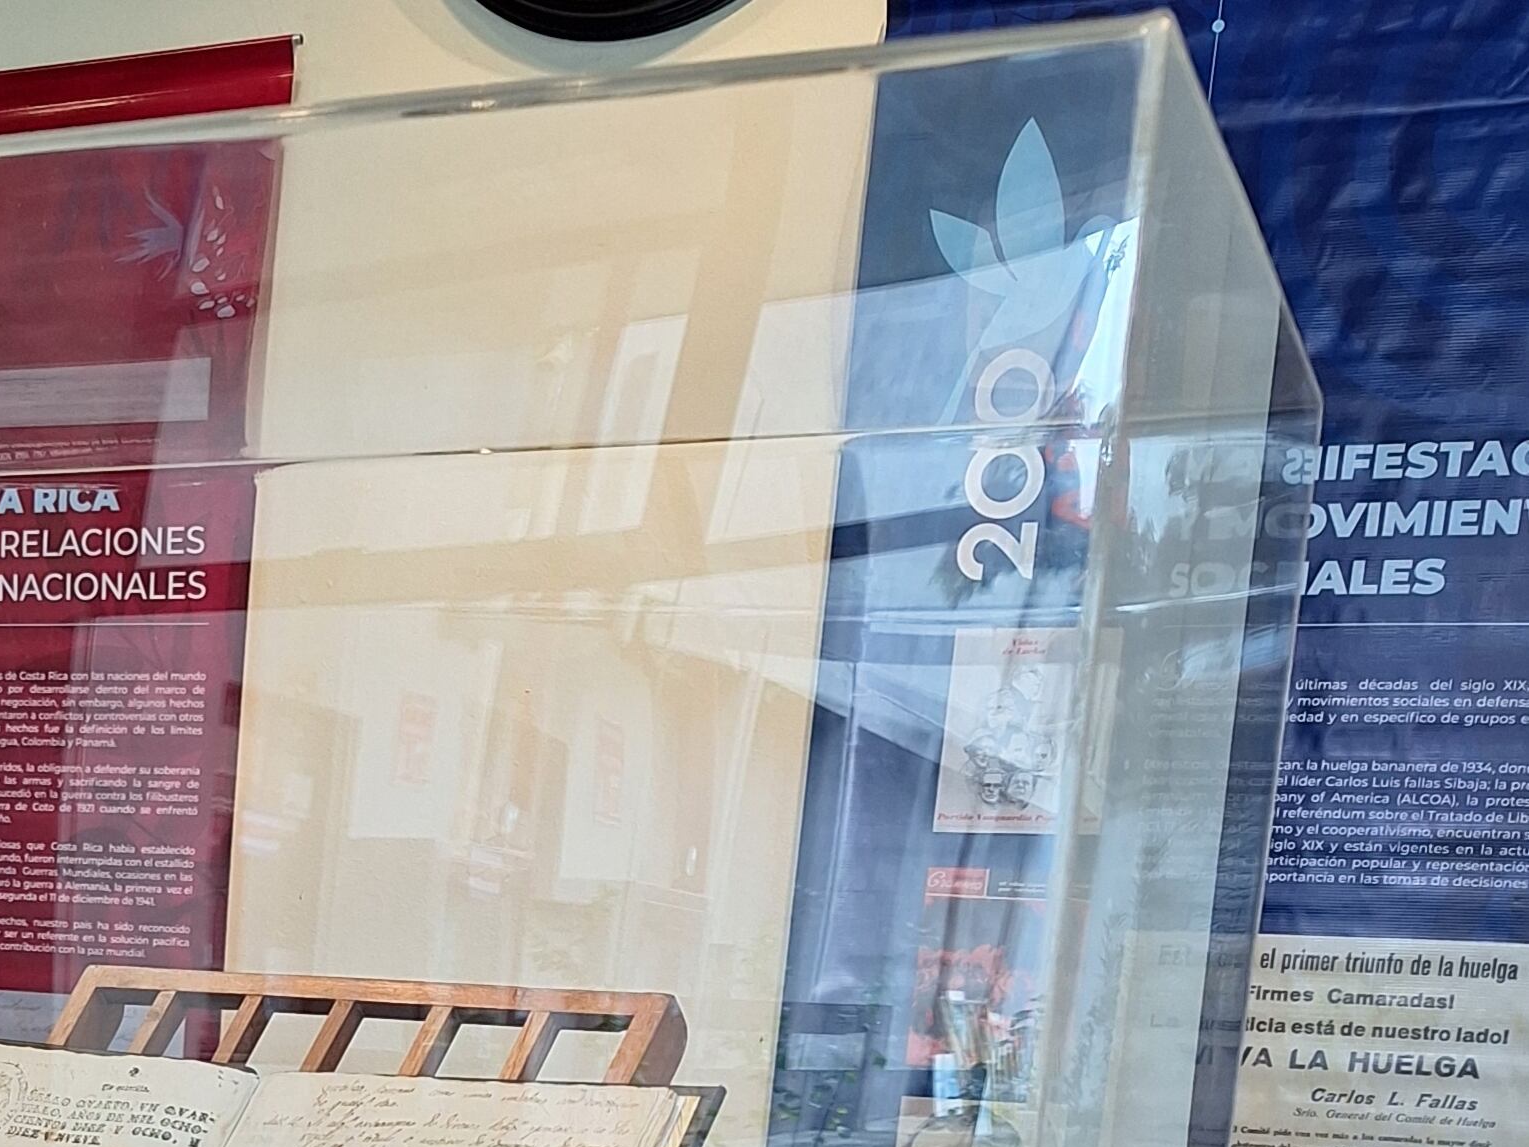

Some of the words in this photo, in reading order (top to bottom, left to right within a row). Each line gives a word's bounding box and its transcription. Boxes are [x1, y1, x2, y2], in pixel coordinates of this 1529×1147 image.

[956, 348, 1056, 581] 200
[33, 488, 121, 514] RICA
[0, 525, 206, 559] RELACIONES
[1294, 678, 1348, 691] últimas
[1358, 678, 1419, 691] décadas
[1429, 678, 1453, 691] del
[1459, 678, 1495, 694] siglo
[1259, 947, 1277, 970] el
[1280, 948, 1340, 974] primer
[1344, 951, 1404, 975] triunfo
[1409, 953, 1432, 976] de
[1437, 954, 1454, 977] la
[1458, 955, 1519, 984] huelga
[1326, 988, 1455, 1010] Camaradas!
[1290, 1019, 1335, 1036] está
[1339, 1021, 1366, 1037] de
[1370, 1025, 1451, 1042] nuestro
[1454, 1026, 1510, 1045] lado!
[1288, 1048, 1329, 1071] LA
[1347, 1051, 1481, 1080] HUELGA
[1310, 1087, 1376, 1106] Carlos
[1386, 1091, 1405, 1107] L.
[1415, 1093, 1479, 1111] Fallas
